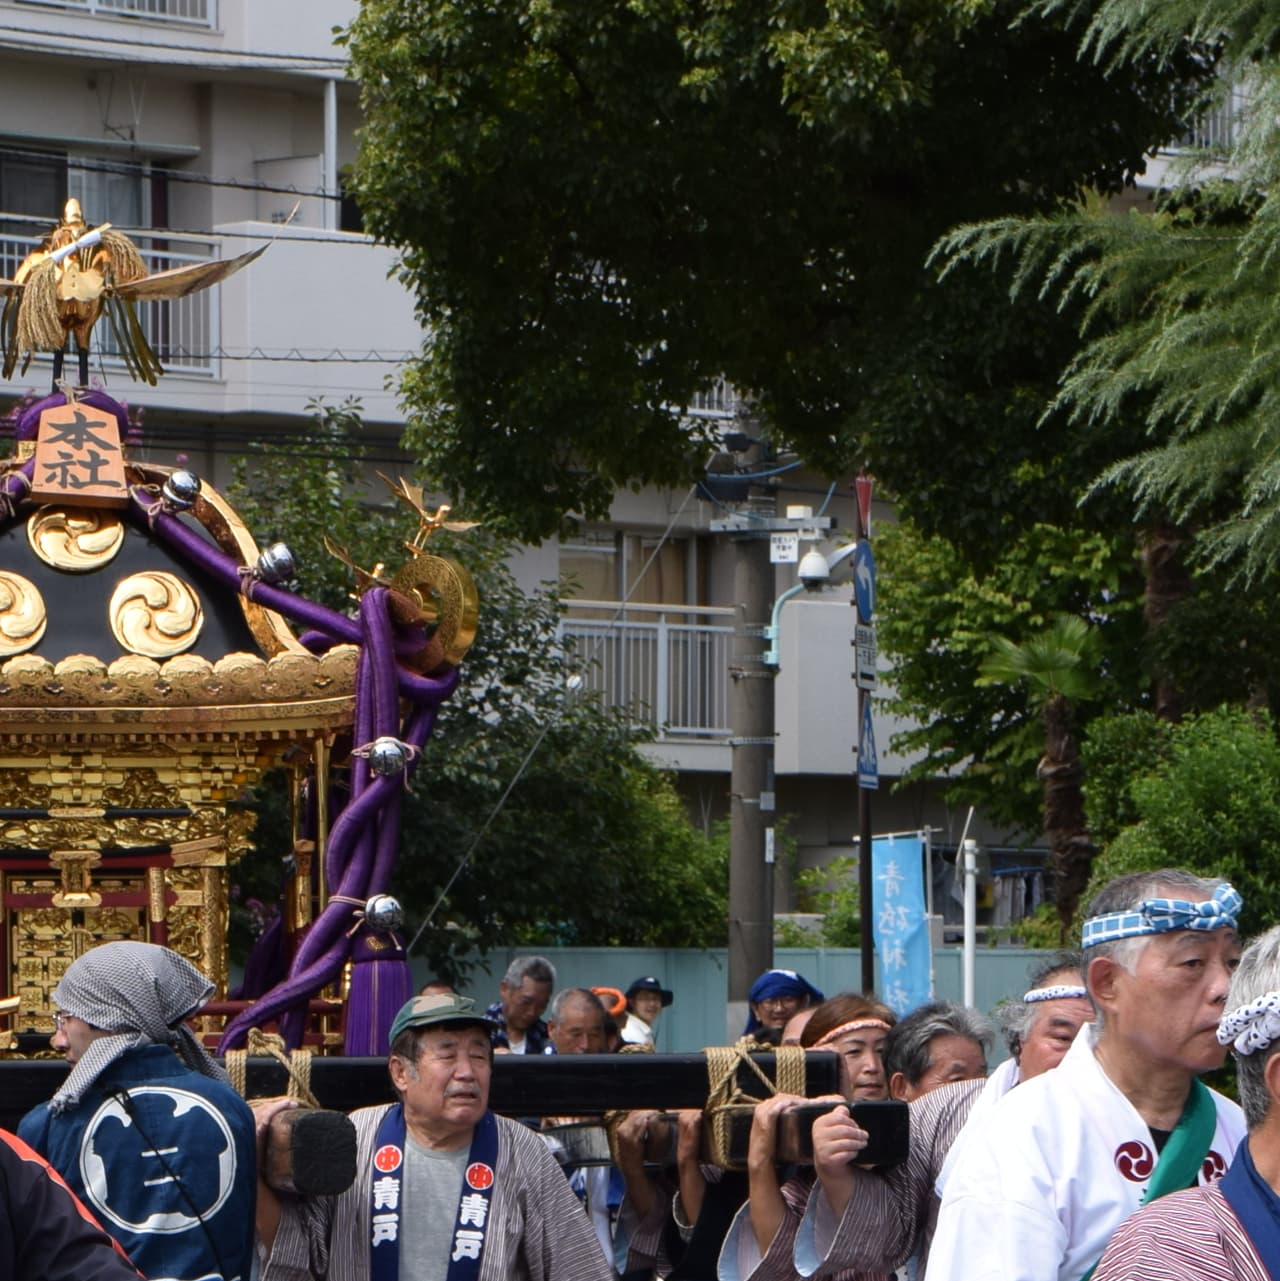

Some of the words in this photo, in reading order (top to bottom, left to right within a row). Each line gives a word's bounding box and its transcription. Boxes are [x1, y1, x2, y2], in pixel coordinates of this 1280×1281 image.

[40, 410, 122, 490] 本社
[372, 1176, 400, 1248] 青戸
[452, 1193, 489, 1263] 青戸
